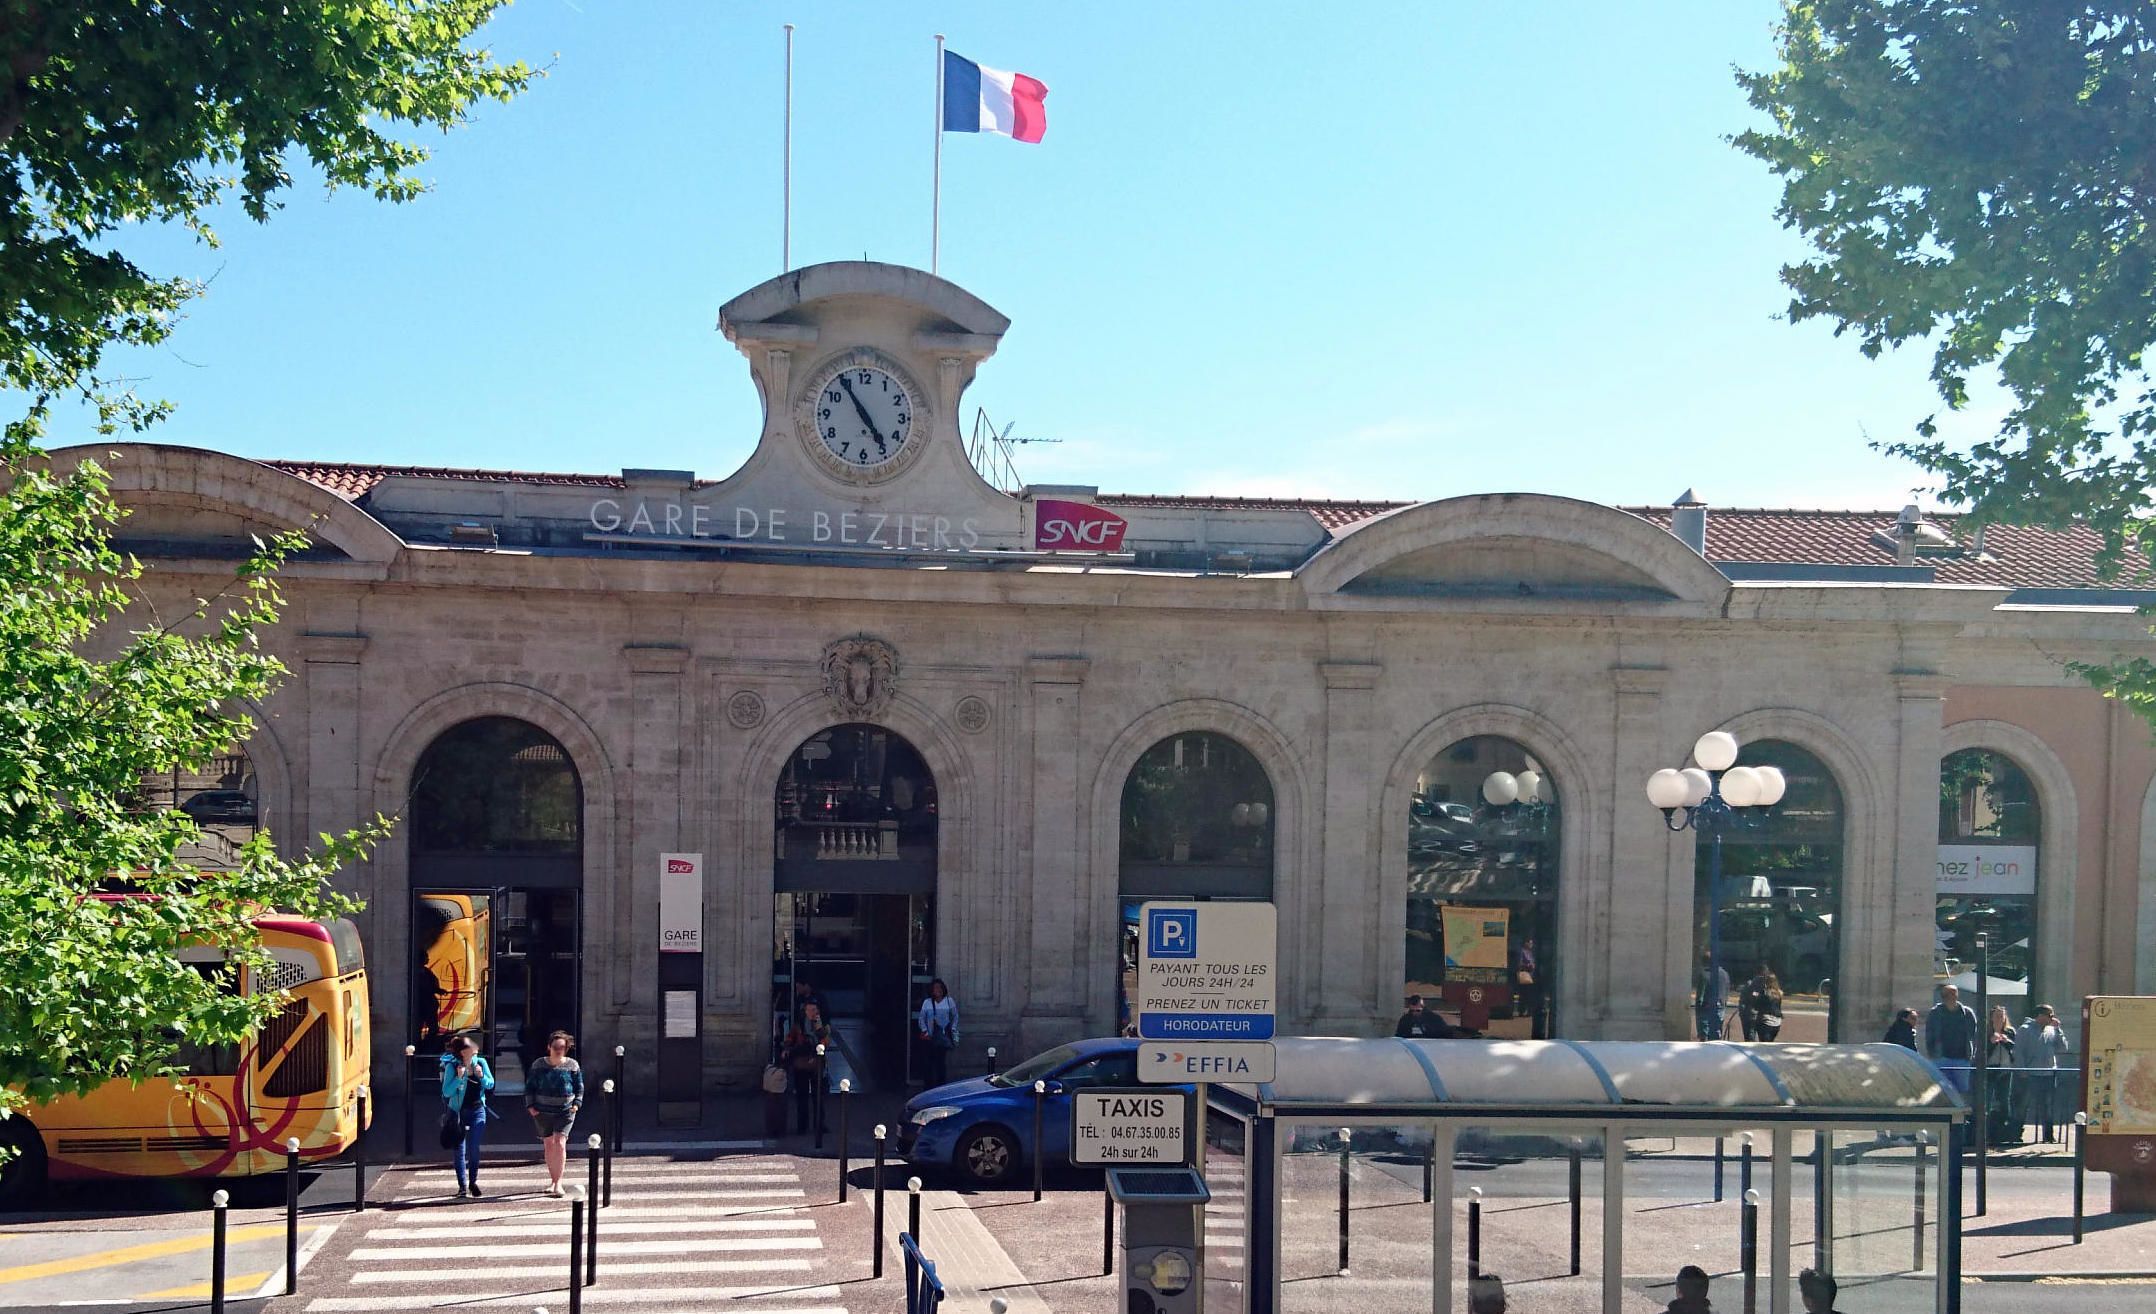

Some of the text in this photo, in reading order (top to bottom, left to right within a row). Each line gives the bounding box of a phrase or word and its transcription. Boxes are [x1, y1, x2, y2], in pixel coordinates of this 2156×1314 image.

[859, 373, 871, 385] 12
[882, 380, 888, 392] 1
[828, 391, 841, 403] 10
[894, 395, 901, 406] 2
[822, 409, 830, 420] 9
[898, 414, 906, 424] 3
[828, 427, 836, 438] 8
[892, 430, 900, 441] 4
[842, 442, 850, 453] 7
[879, 443, 887, 455] 5
[860, 448, 868, 460] 6
[590, 499, 979, 548] GARE DE BEZIERS
[1040, 520, 1124, 544] SNCF
[669, 864, 693, 873] SNCF
[1974, 856, 2019, 880] jean
[664, 930, 697, 941] GARE
[1162, 920, 1183, 947] P
[1150, 963, 1267, 975] PAYANT TOUS LES
[1162, 977, 1205, 988] JOURS
[1146, 999, 1269, 1010] PRENEZ UN TICKET
[1163, 1020, 1250, 1031] HORODATEUR
[1186, 1056, 1249, 1073] EFFIA
[1097, 1098, 1164, 1118] TAXIS
[1111, 1126, 1180, 1139] 04.67.35.00.85
[1101, 1146, 1158, 1159] 24h sur 24h
